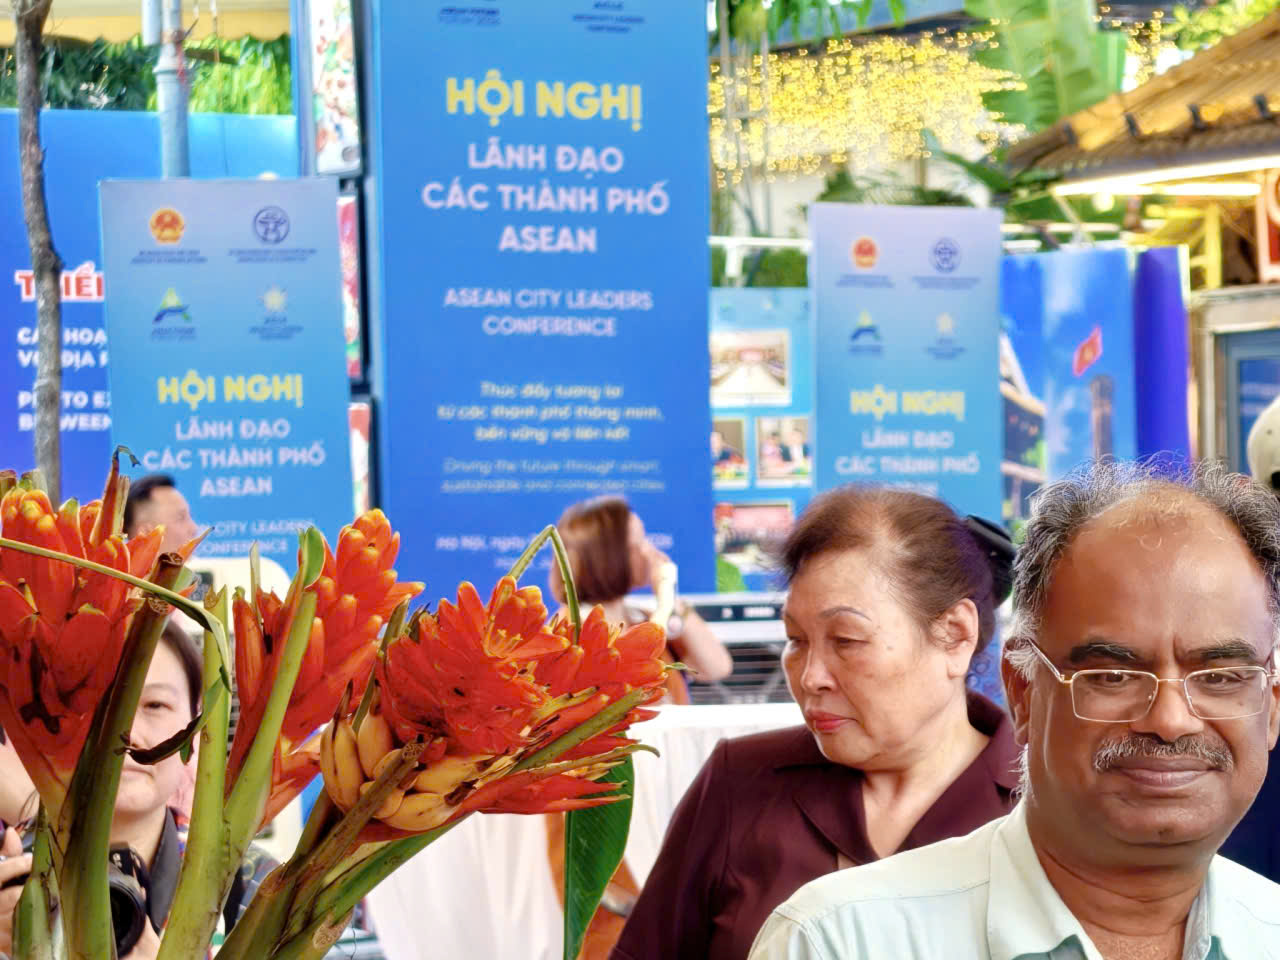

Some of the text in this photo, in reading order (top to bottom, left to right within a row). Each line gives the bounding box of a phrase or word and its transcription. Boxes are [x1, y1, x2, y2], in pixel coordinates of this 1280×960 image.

[446, 69, 642, 132] HỘI NGHỊ
[468, 136, 624, 180] LÃNH ĐẠO
[421, 176, 670, 215] CÁC THÀNH PHỐ
[499, 225, 597, 252] ASEAN
[444, 288, 654, 311] ASEAN CITY LEADERS
[482, 315, 617, 337] CONFERENCE
[157, 370, 303, 410] HỘI NGHỊ
[850, 384, 965, 422] HỘI NGHỊ
[175, 416, 291, 444] LÃNH ĐẠO
[143, 440, 326, 470] CÁC THÀNH PHỐ
[200, 476, 273, 496] ASEAN
